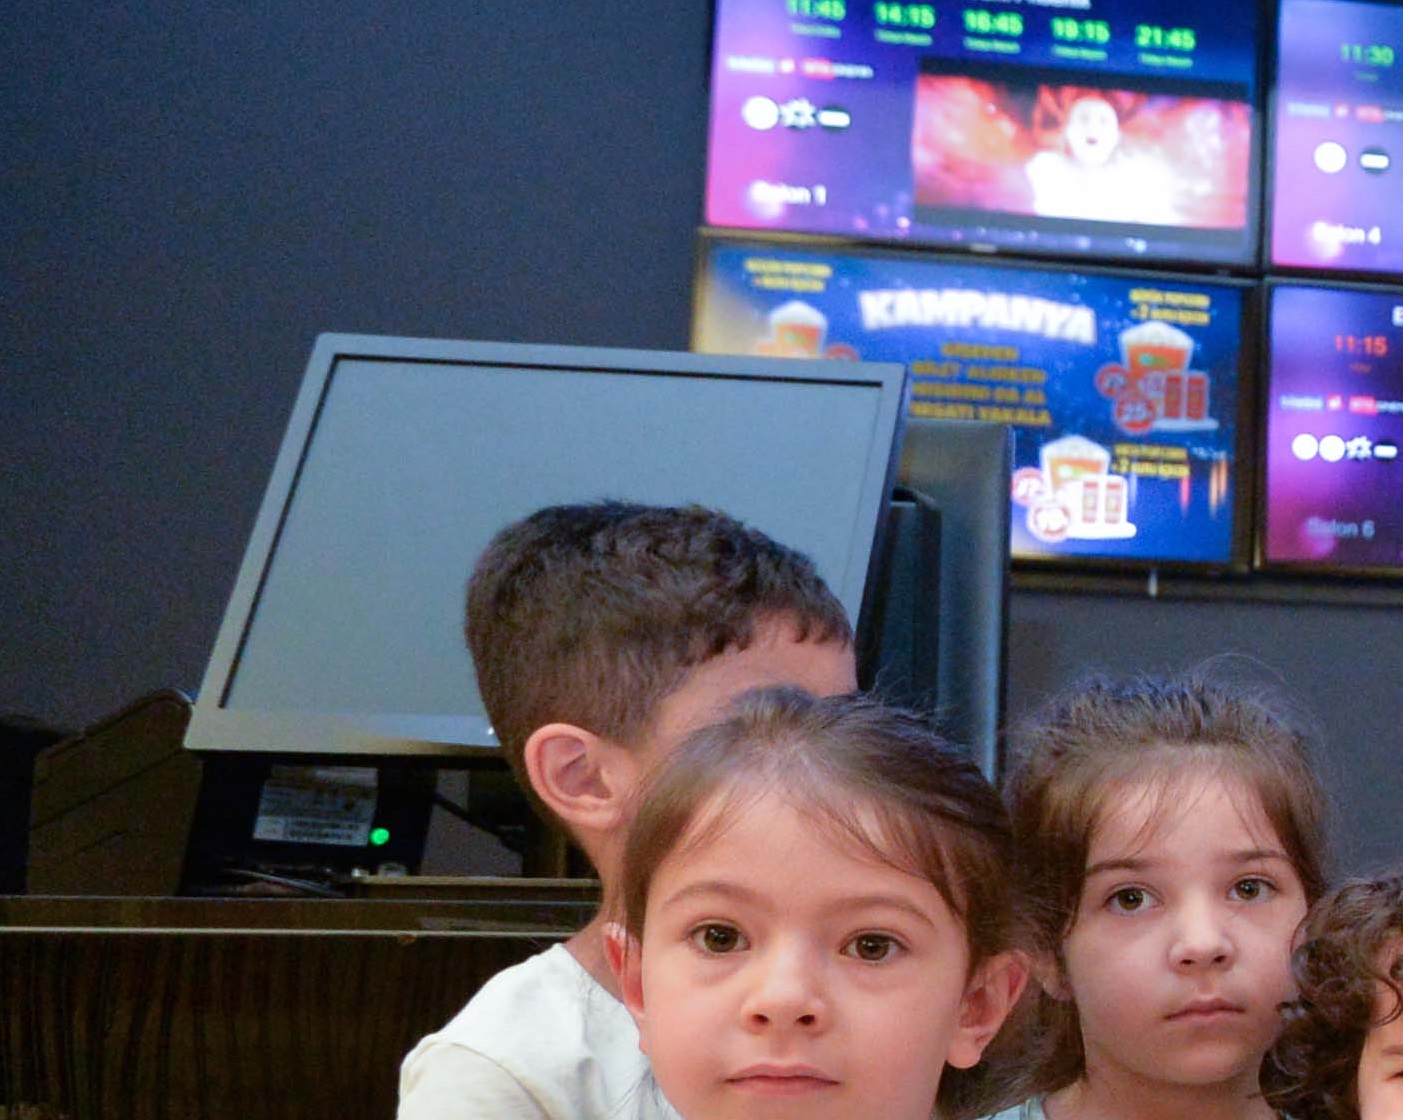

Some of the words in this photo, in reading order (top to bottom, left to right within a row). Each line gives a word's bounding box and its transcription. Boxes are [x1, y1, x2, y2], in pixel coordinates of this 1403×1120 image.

[1340, 44, 1394, 67] 11:30
[859, 287, 1097, 345] KAMPANYA
[1335, 335, 1388, 356] 11:15
